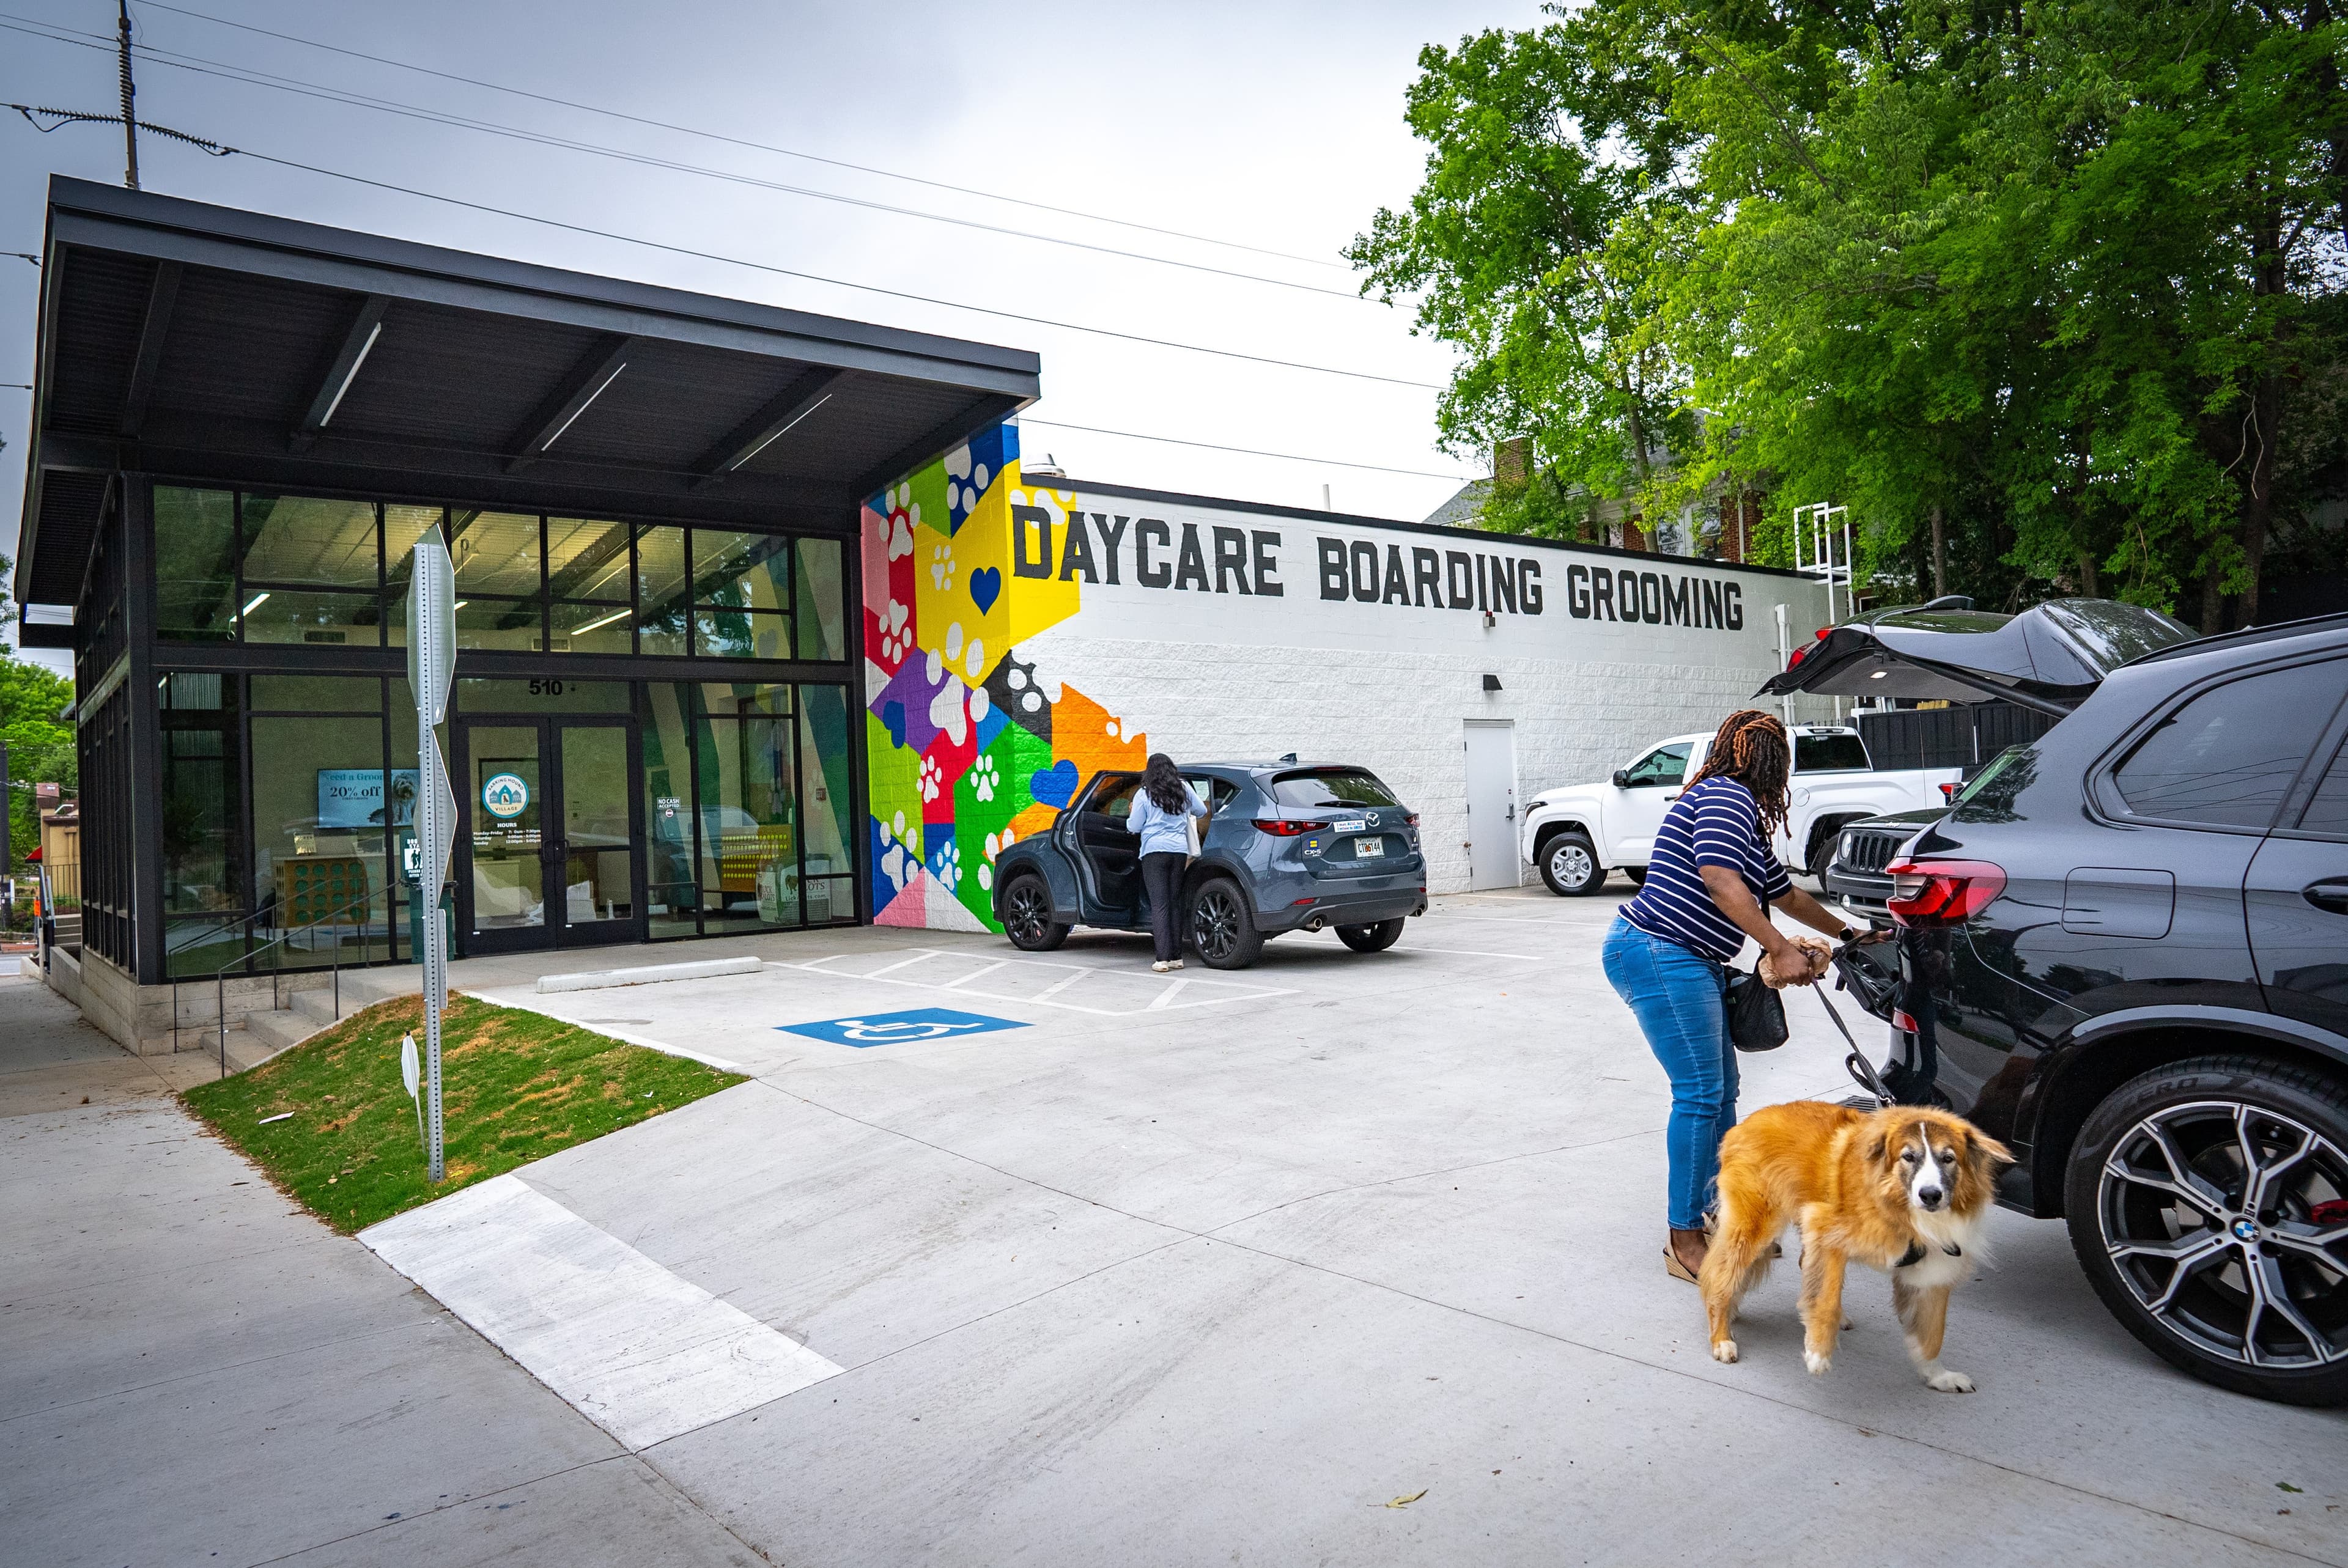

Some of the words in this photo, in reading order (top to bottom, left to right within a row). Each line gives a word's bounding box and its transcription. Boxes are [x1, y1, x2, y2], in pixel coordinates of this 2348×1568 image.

[1010, 504, 1284, 597] DAYCARE
[1316, 536, 1543, 615] BOARDING
[1567, 563, 1743, 631] GROOMING
[529, 679, 563, 696] 510
[488, 778, 507, 790] BARKING
[508, 778, 524, 790] HOUND
[330, 786, 358, 797] 20%
[361, 786, 381, 797] off
